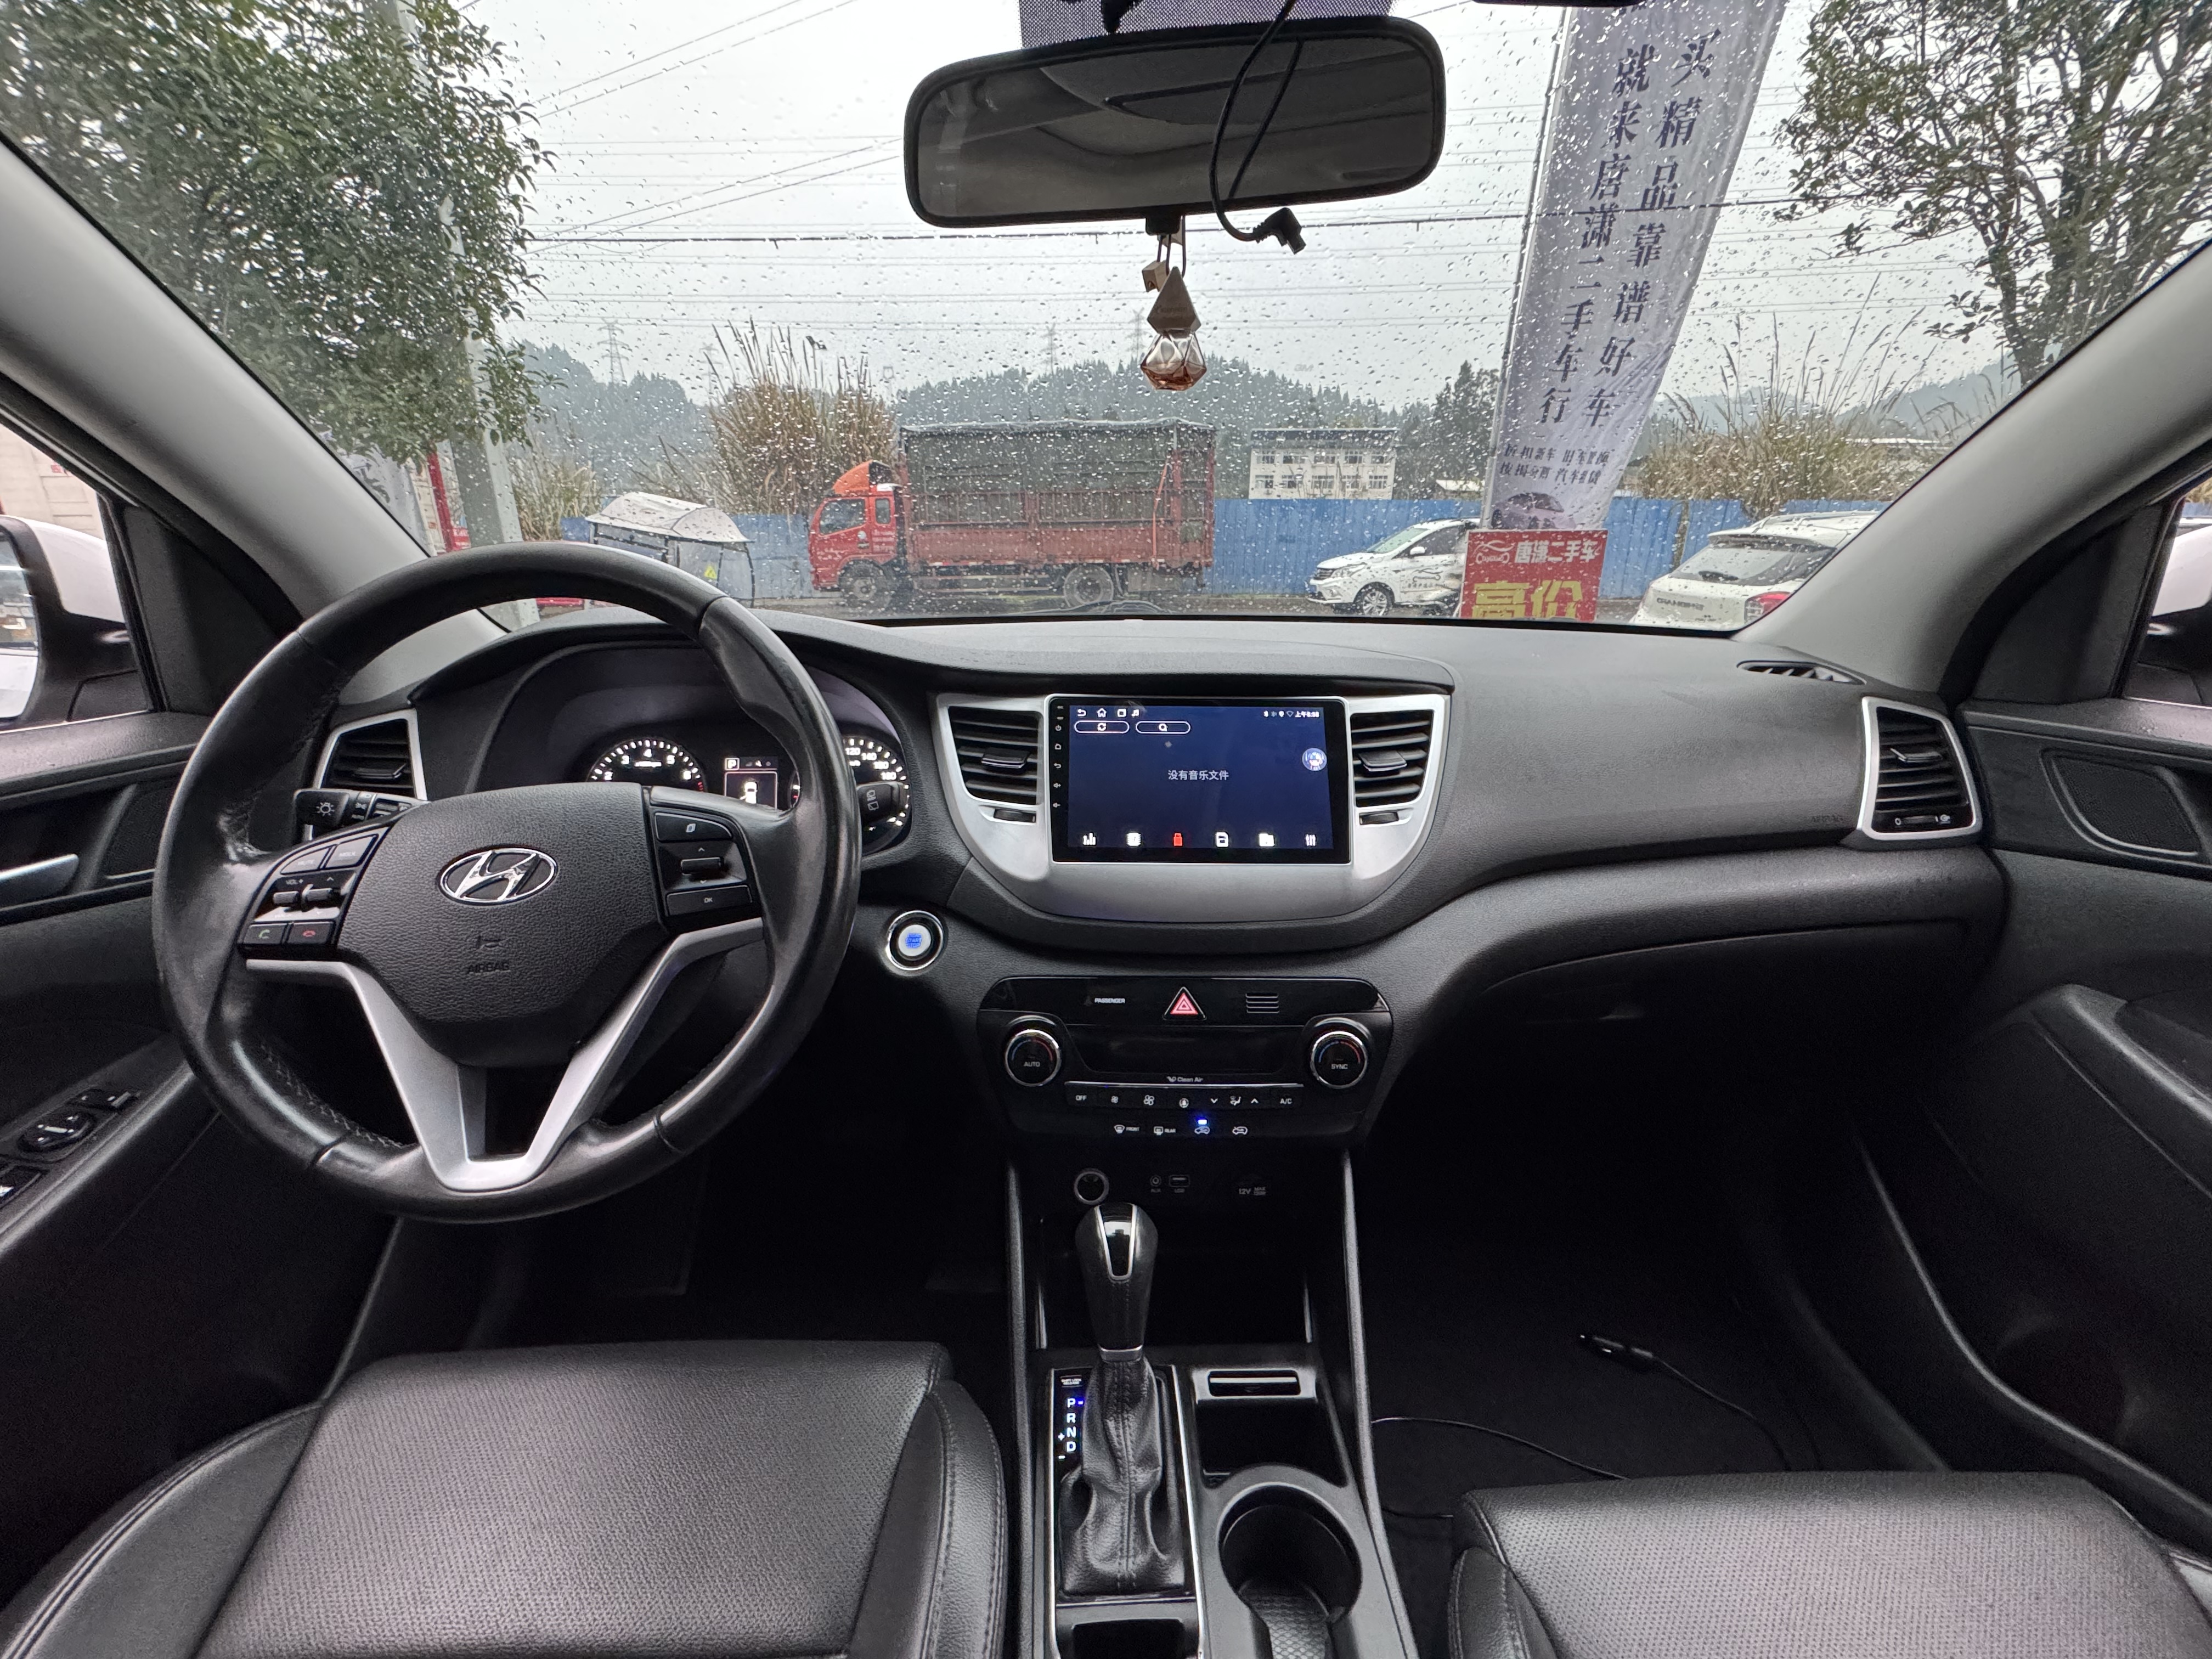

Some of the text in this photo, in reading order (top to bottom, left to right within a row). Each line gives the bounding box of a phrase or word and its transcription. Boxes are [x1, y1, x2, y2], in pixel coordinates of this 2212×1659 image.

[1585, 27, 1722, 426] 买精品靠谱好车
[1472, 580, 1583, 619] 高价
[643, 748, 652, 757] 4
[845, 747, 861, 755] 120
[621, 755, 630, 764] 3
[666, 754, 675, 764] 5
[605, 771, 613, 780] 2
[683, 770, 692, 780] 6
[1168, 770, 1229, 781] 没有音乐文件
[468, 963, 510, 973] AIRBAG
[1067, 1398, 1076, 1408] P
[1067, 1413, 1076, 1424] R
[1067, 1426, 1076, 1438] N
[1066, 1441, 1076, 1452] D
